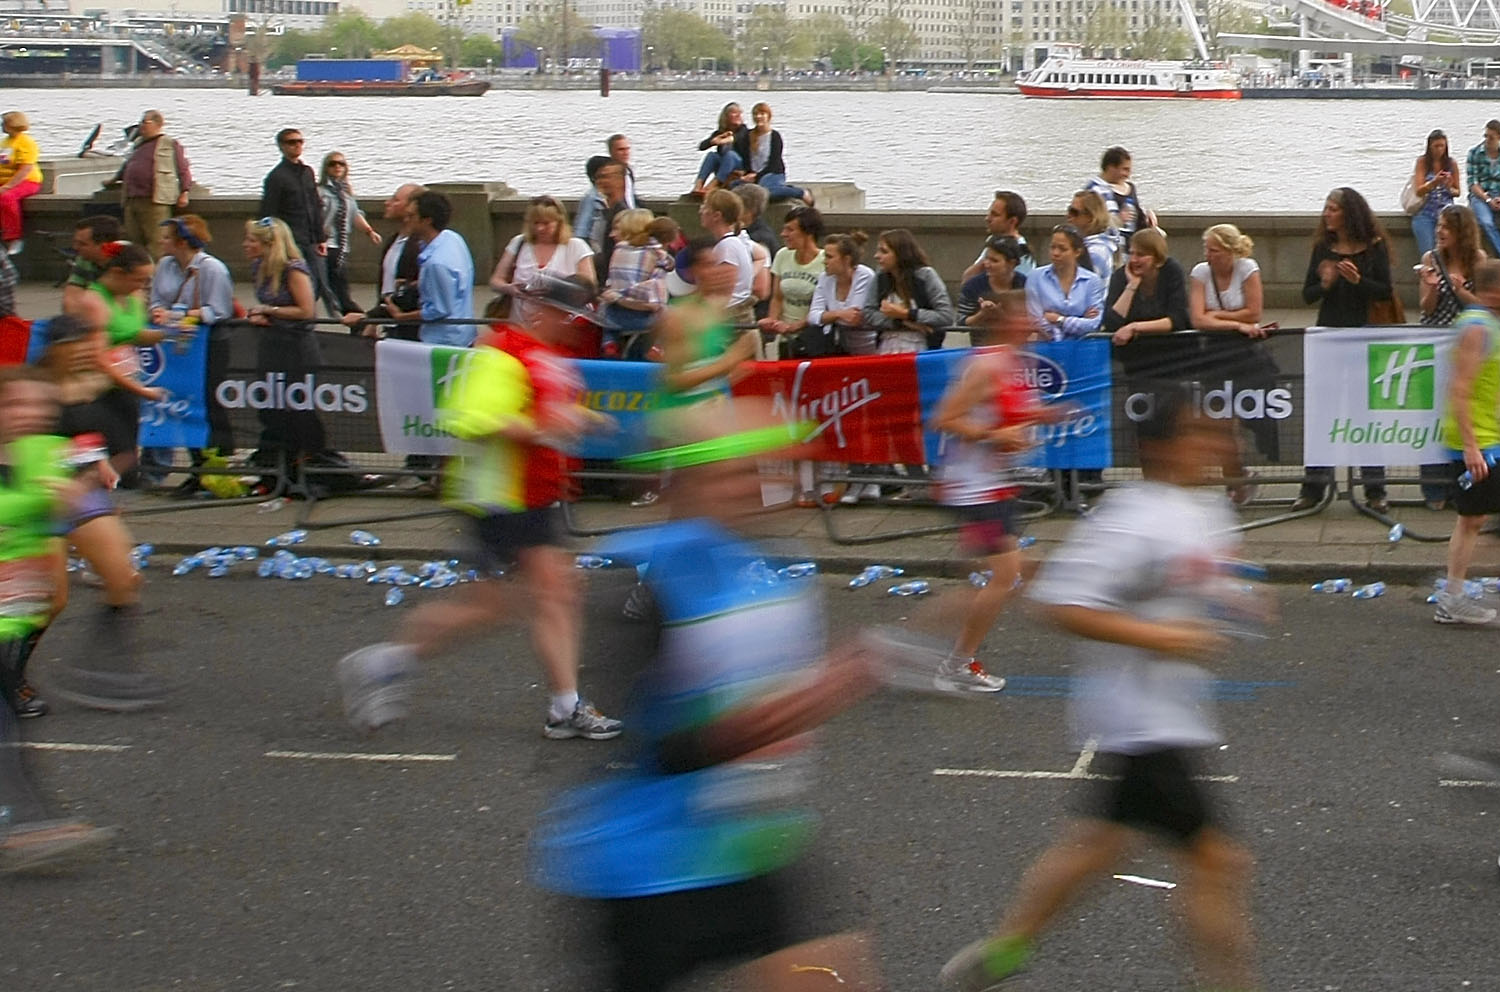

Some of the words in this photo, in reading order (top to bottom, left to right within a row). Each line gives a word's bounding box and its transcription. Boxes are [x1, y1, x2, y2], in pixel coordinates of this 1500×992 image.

[215, 371, 369, 413] adidas
[771, 361, 882, 449] Virgin
[1124, 380, 1293, 422] aidas
[1328, 418, 1429, 449] Holiday
